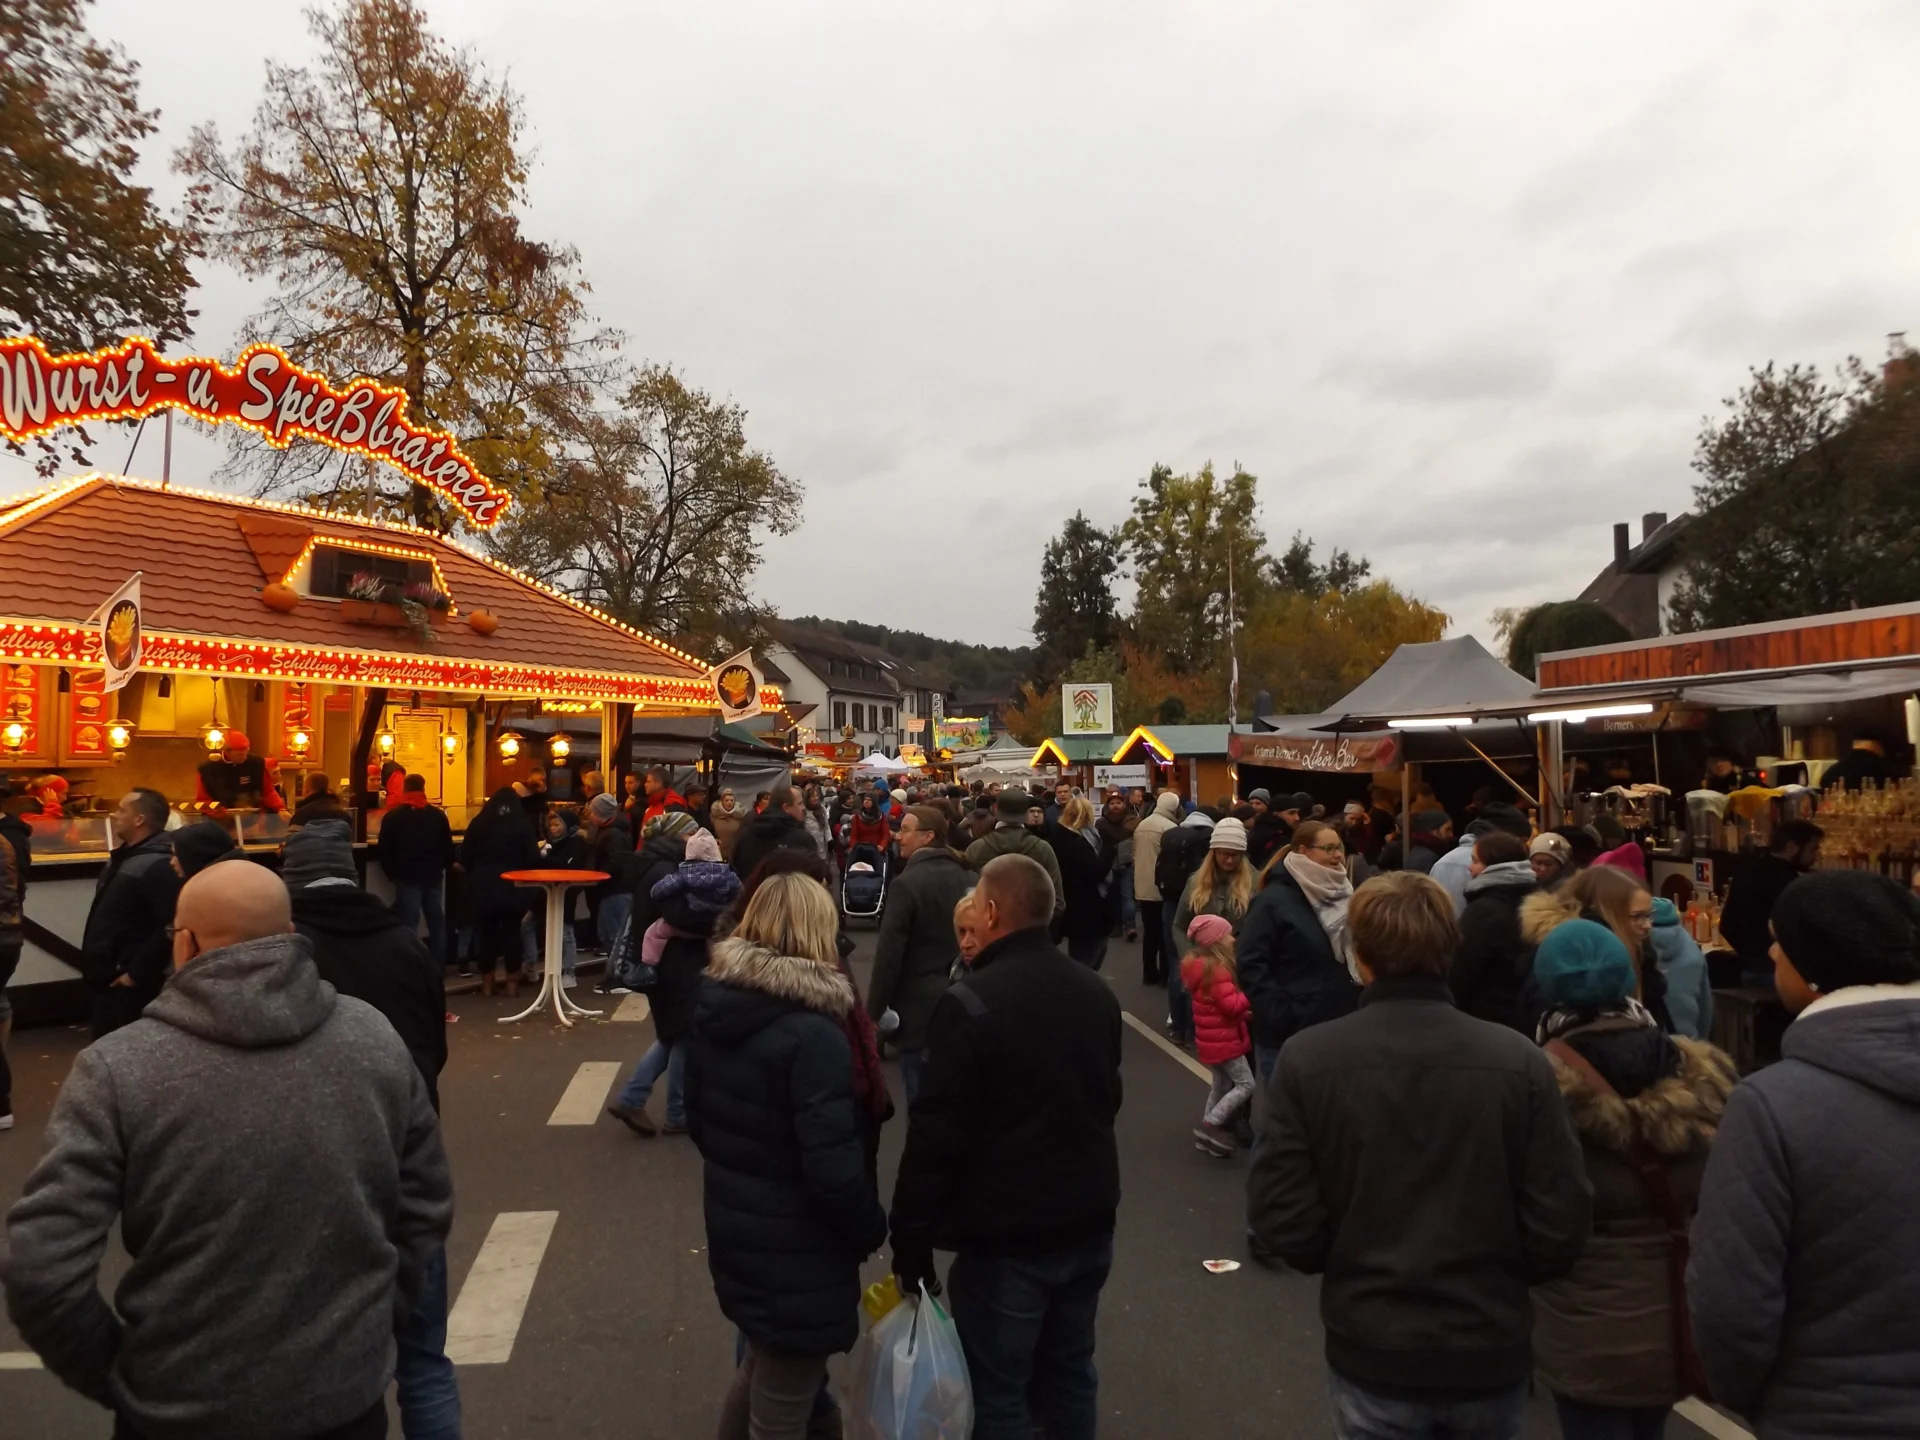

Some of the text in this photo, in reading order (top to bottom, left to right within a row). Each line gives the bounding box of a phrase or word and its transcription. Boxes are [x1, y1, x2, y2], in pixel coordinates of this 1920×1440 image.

[188, 368, 219, 413] u.
[240, 353, 505, 521] Spießbraterei
[269, 653, 443, 682] Schilling's Spezialitäten
[489, 670, 618, 693] Schilling's Spezialitäten
[1302, 739, 1335, 769] Likör
[1335, 738, 1359, 770] Bar
